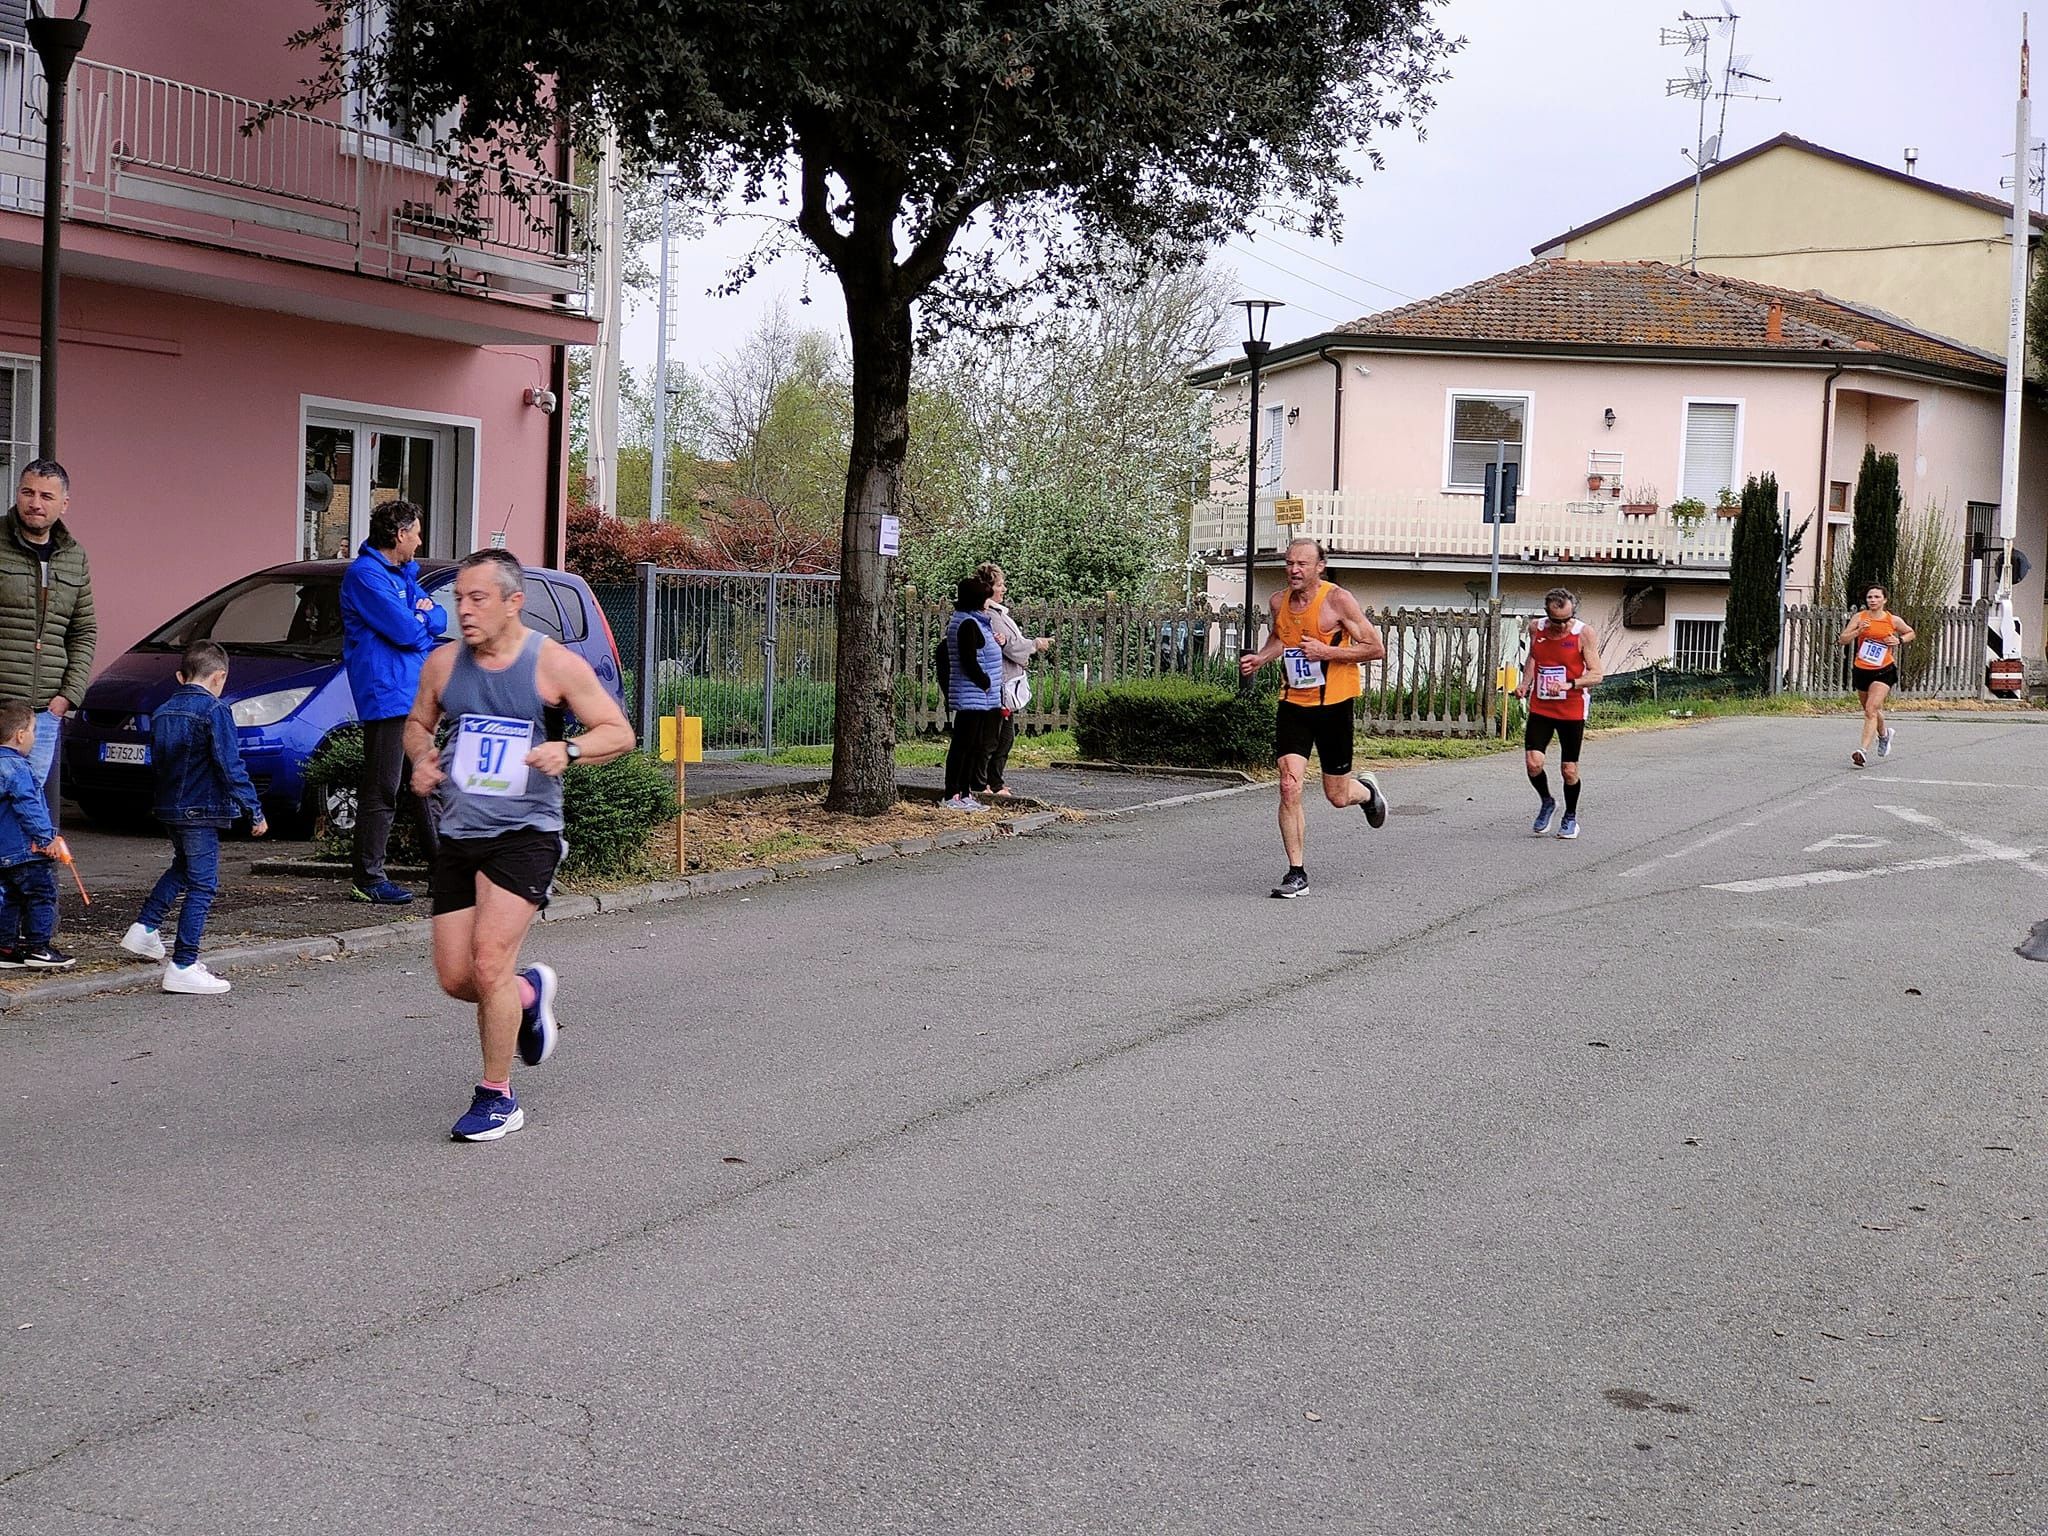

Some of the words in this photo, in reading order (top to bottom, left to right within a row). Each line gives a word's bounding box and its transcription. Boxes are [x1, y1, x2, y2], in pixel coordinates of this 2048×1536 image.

[1866, 645, 1882, 659] 196
[1295, 659, 1312, 678] 45
[478, 737, 507, 774] 97
